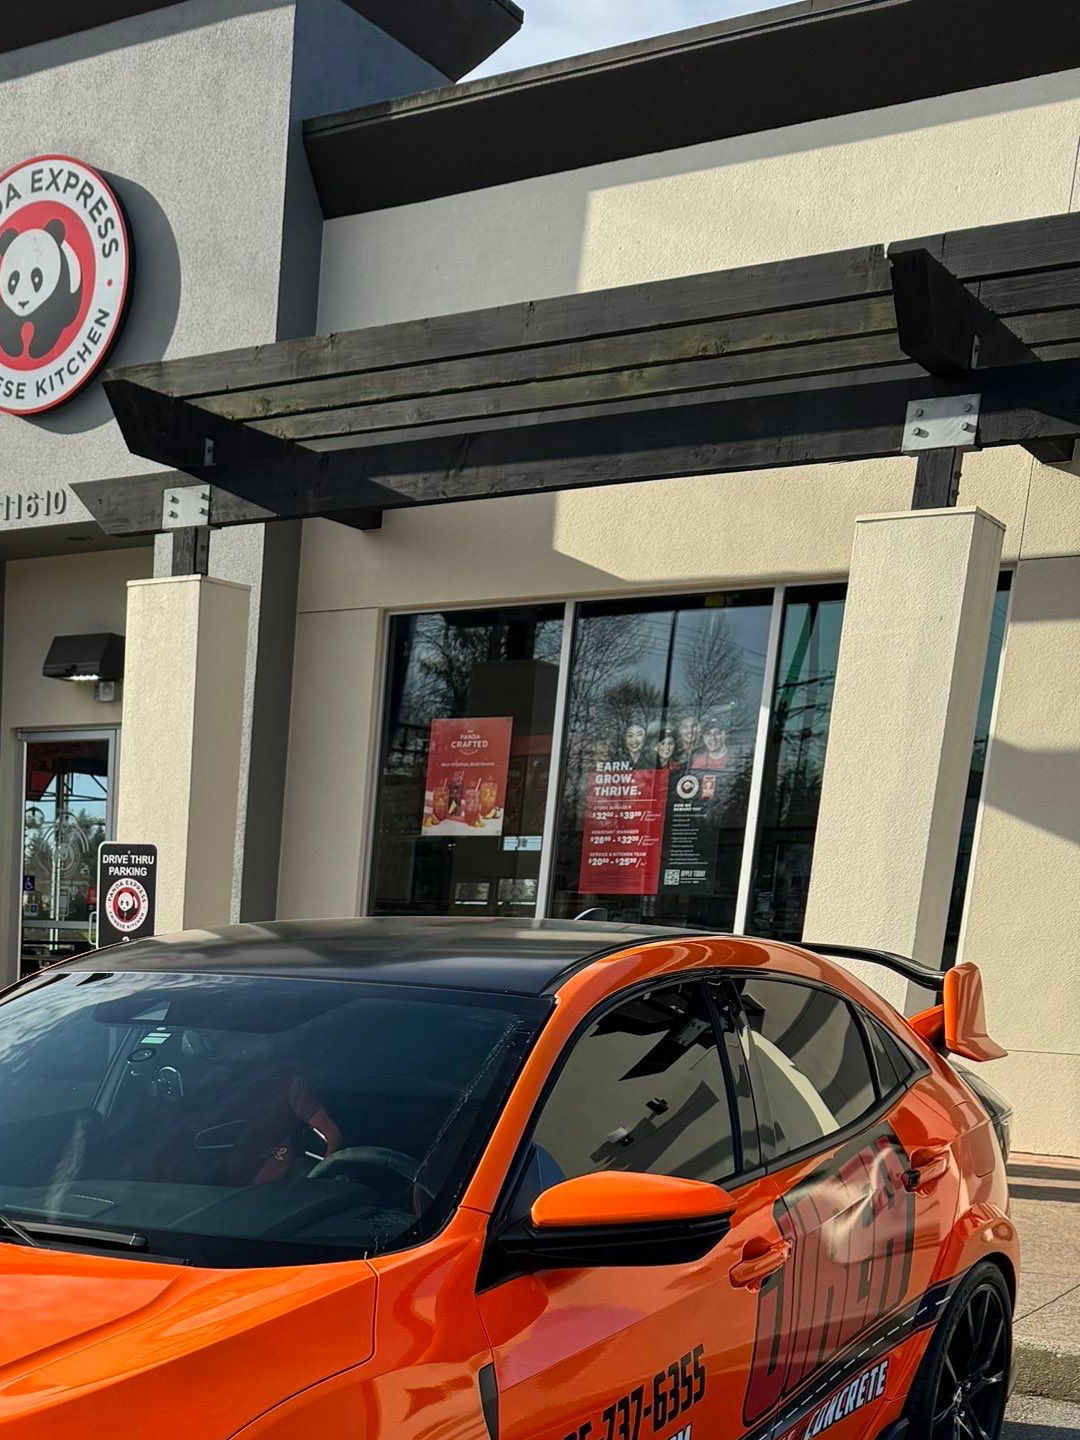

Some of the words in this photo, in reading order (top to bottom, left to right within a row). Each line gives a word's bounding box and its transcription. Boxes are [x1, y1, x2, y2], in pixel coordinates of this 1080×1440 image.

[31, 167, 119, 258] EXPRESS
[35, 308, 110, 397] KITCHEN
[0, 488, 67, 521] 11610
[451, 740, 488, 748] CRAFTED
[596, 761, 633, 771] EARN.
[595, 774, 635, 784] GROW.
[594, 786, 642, 796] THRIVE.
[102, 854, 128, 864] DRIVE
[130, 855, 155, 865] THRU
[108, 866, 148, 876] PARKING
[108, 880, 124, 902] PANDA
[125, 879, 147, 903] EXPRESS
